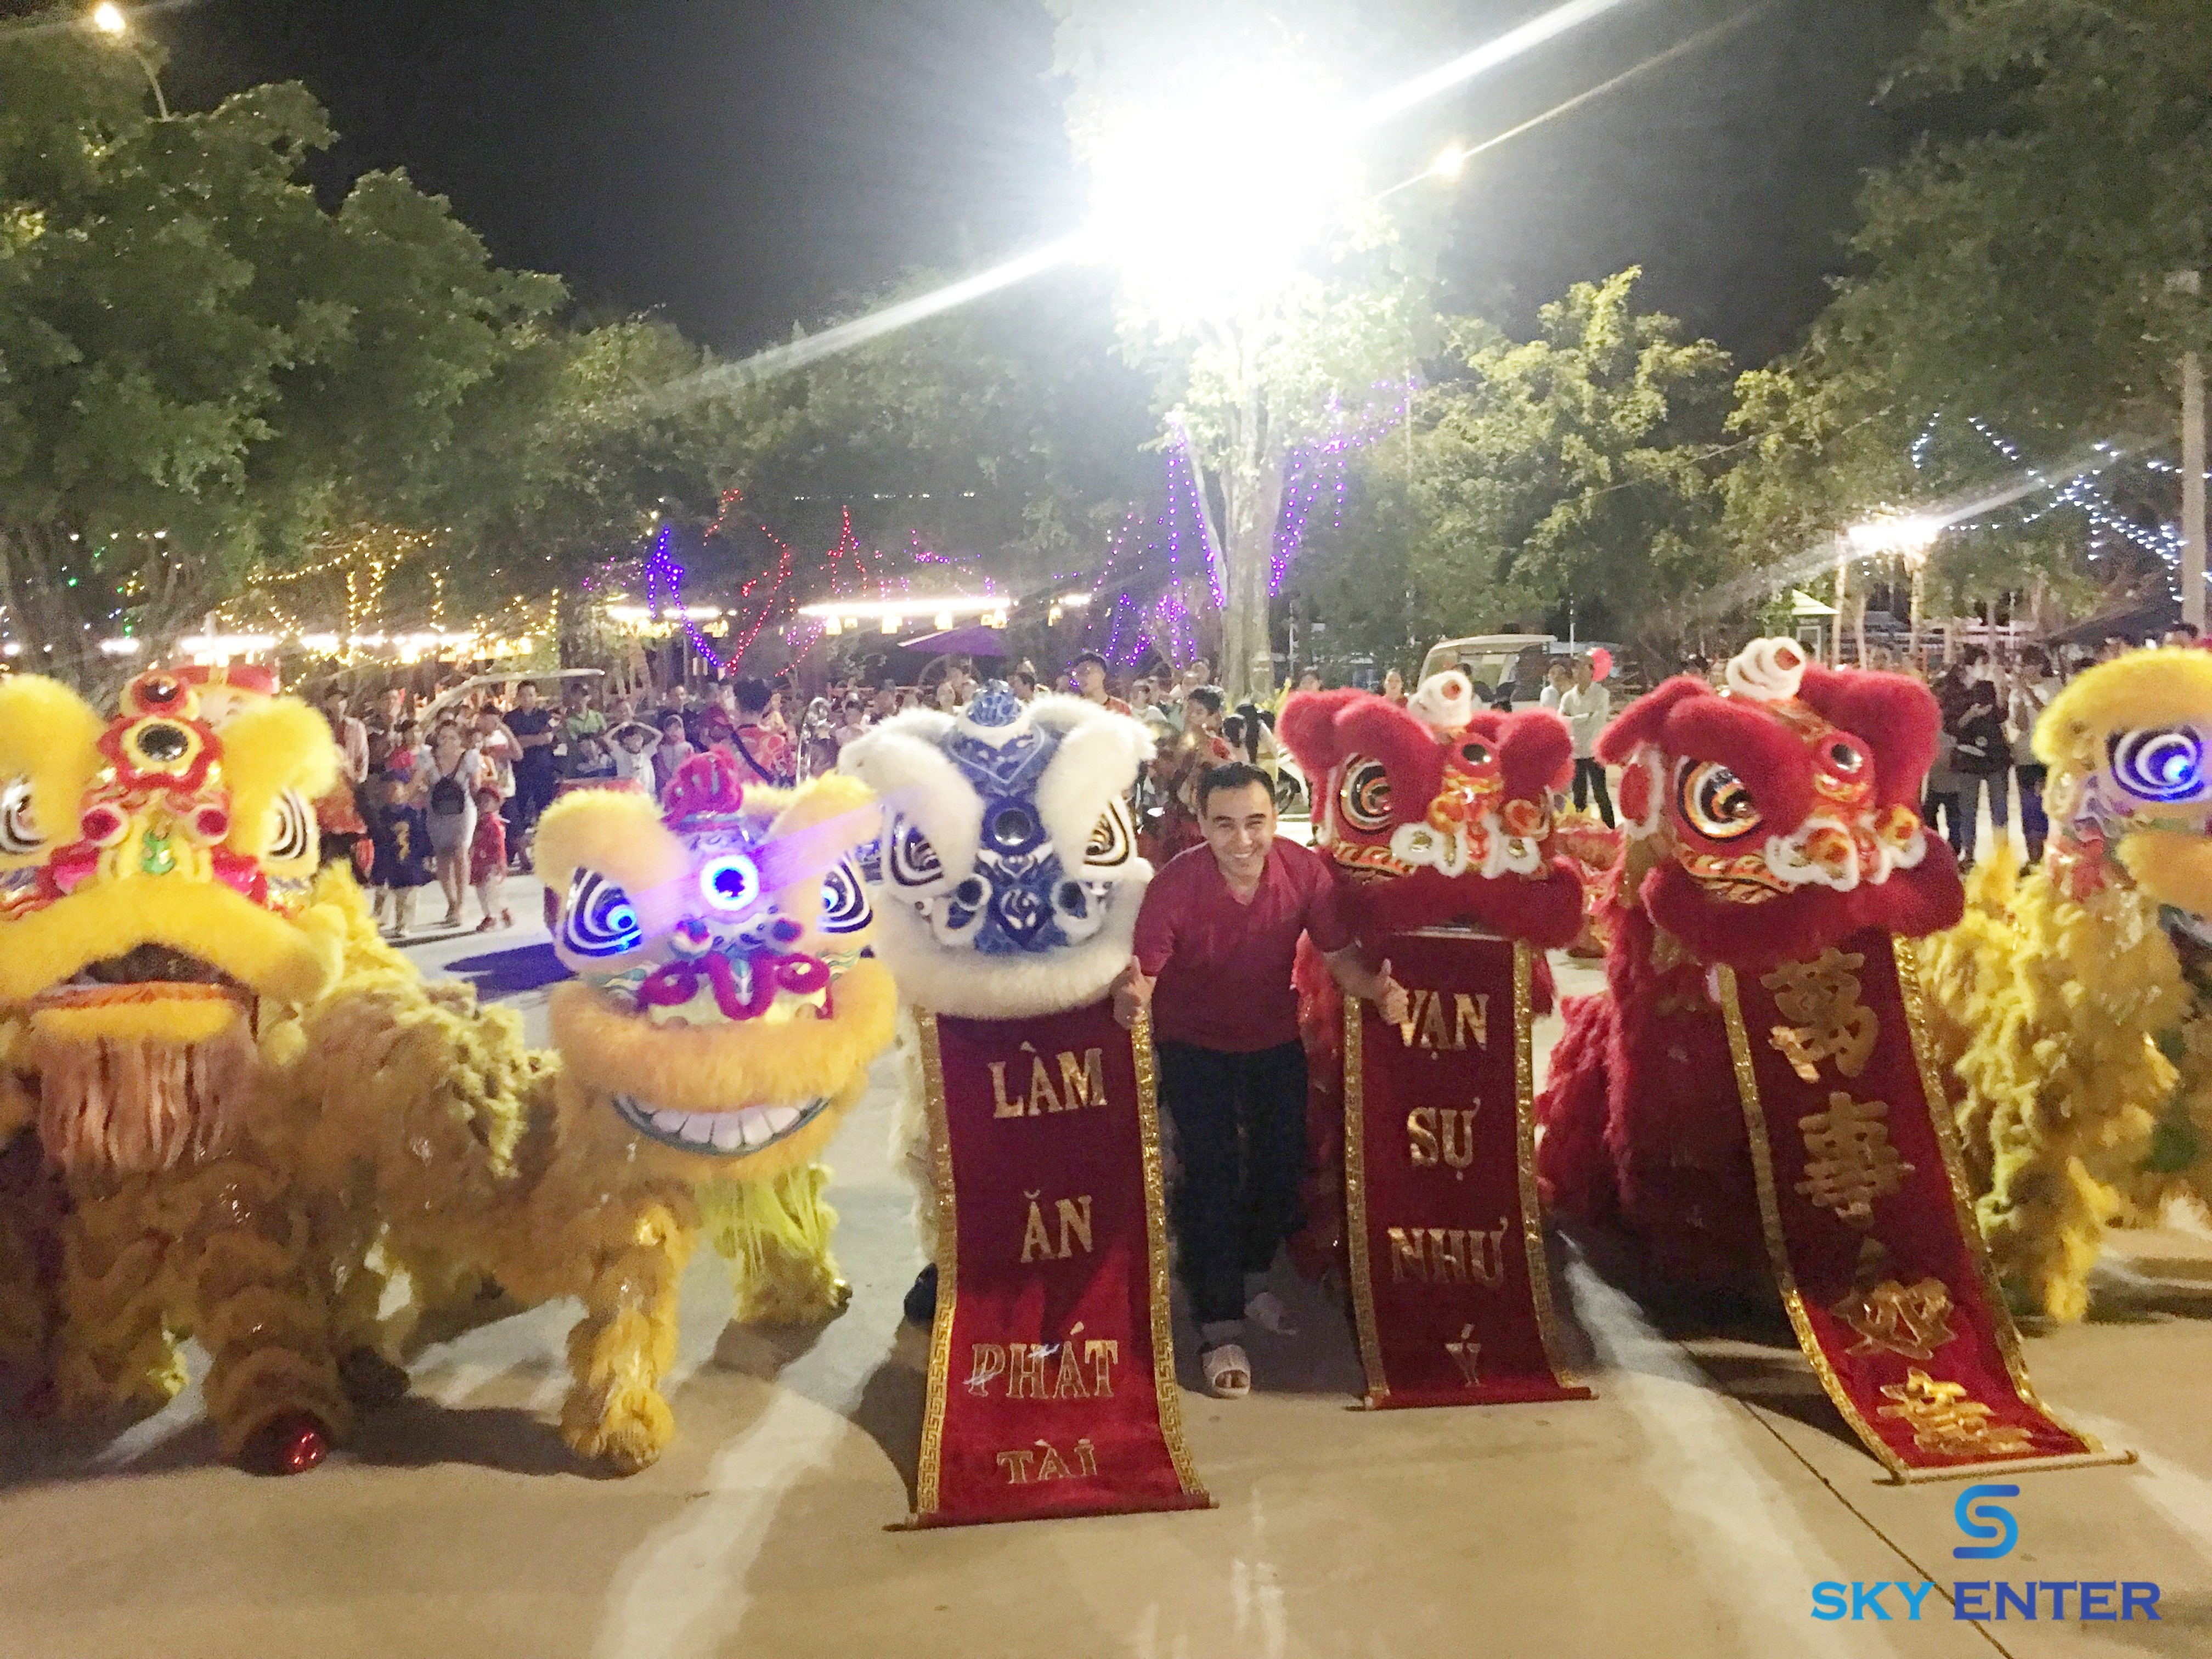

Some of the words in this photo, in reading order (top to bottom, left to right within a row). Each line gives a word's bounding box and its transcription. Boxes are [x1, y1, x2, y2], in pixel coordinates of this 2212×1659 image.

[988, 1041, 1108, 1119] LÀM
[1406, 1097, 1481, 1181] SỰ
[1020, 1189, 1092, 1263] ĂN
[1387, 1216, 1508, 1289] NHƯ
[968, 1321, 1119, 1399] PHÁT
[1445, 1323, 1482, 1388] Ý
